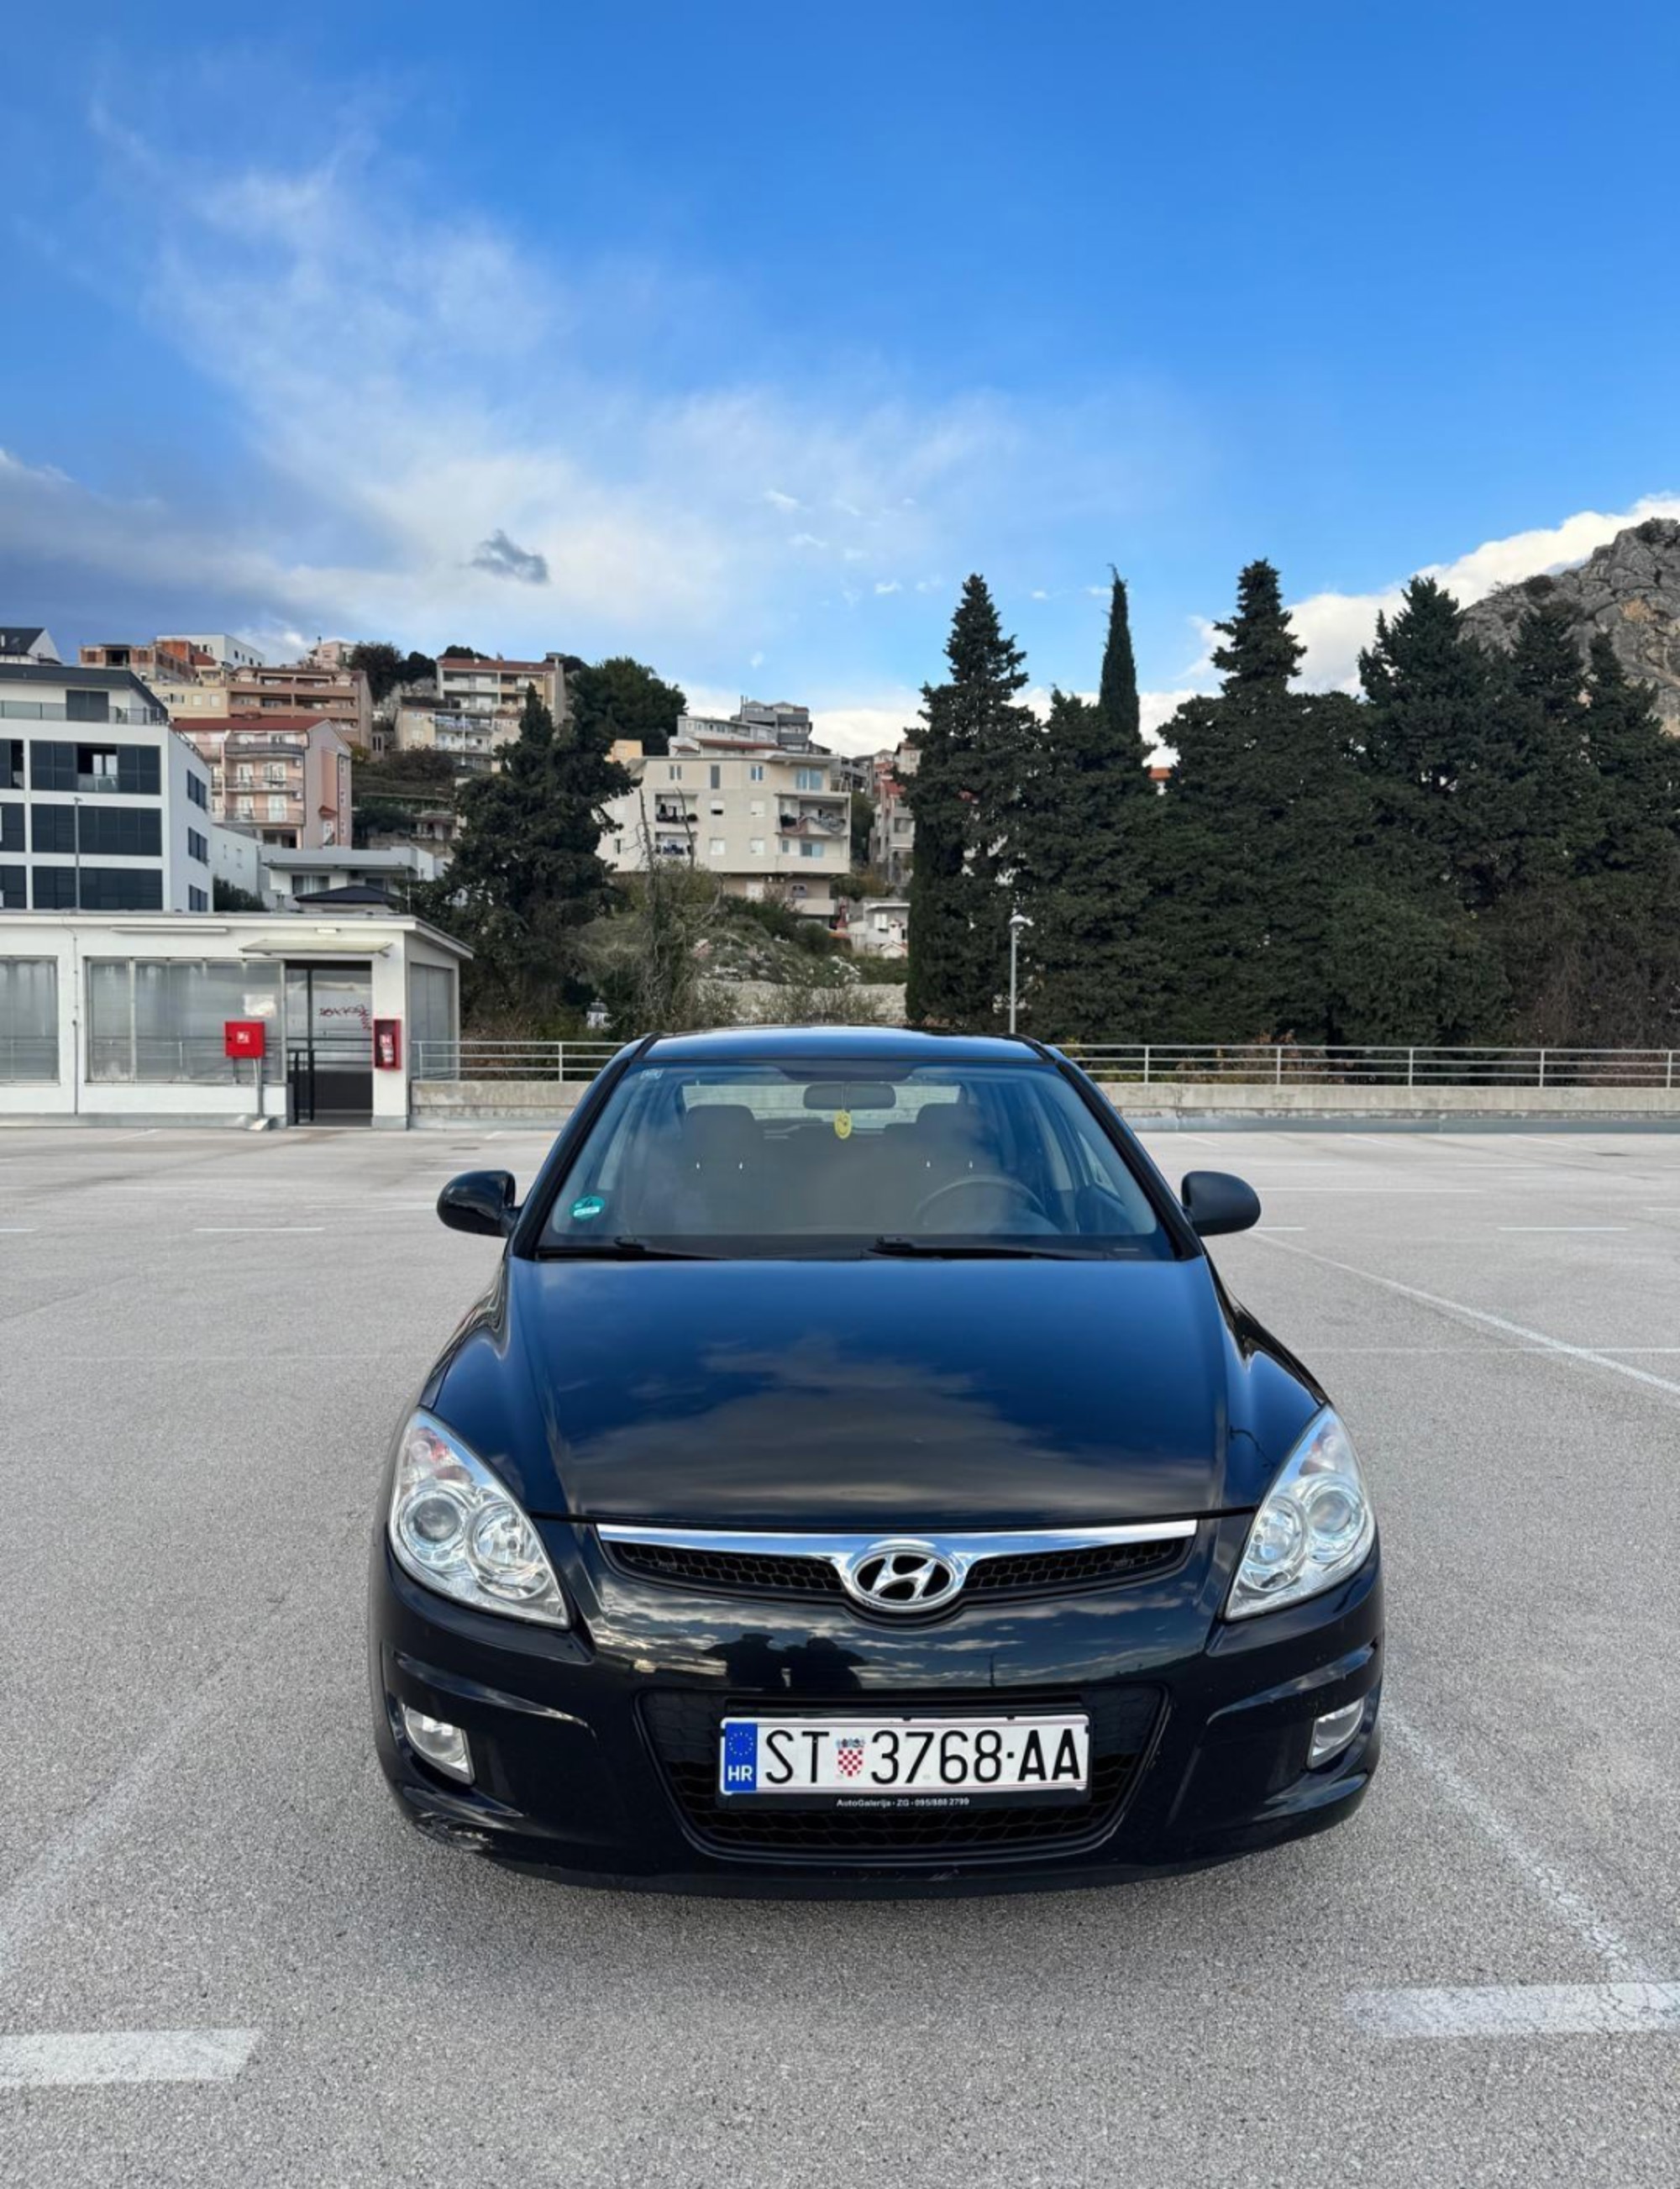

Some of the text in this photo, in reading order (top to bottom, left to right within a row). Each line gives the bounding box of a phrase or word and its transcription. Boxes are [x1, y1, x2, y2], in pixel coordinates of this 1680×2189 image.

[765, 1730, 830, 1784] ST
[727, 1765, 753, 1782] HR
[837, 1798, 891, 1808] AutoGalerija
